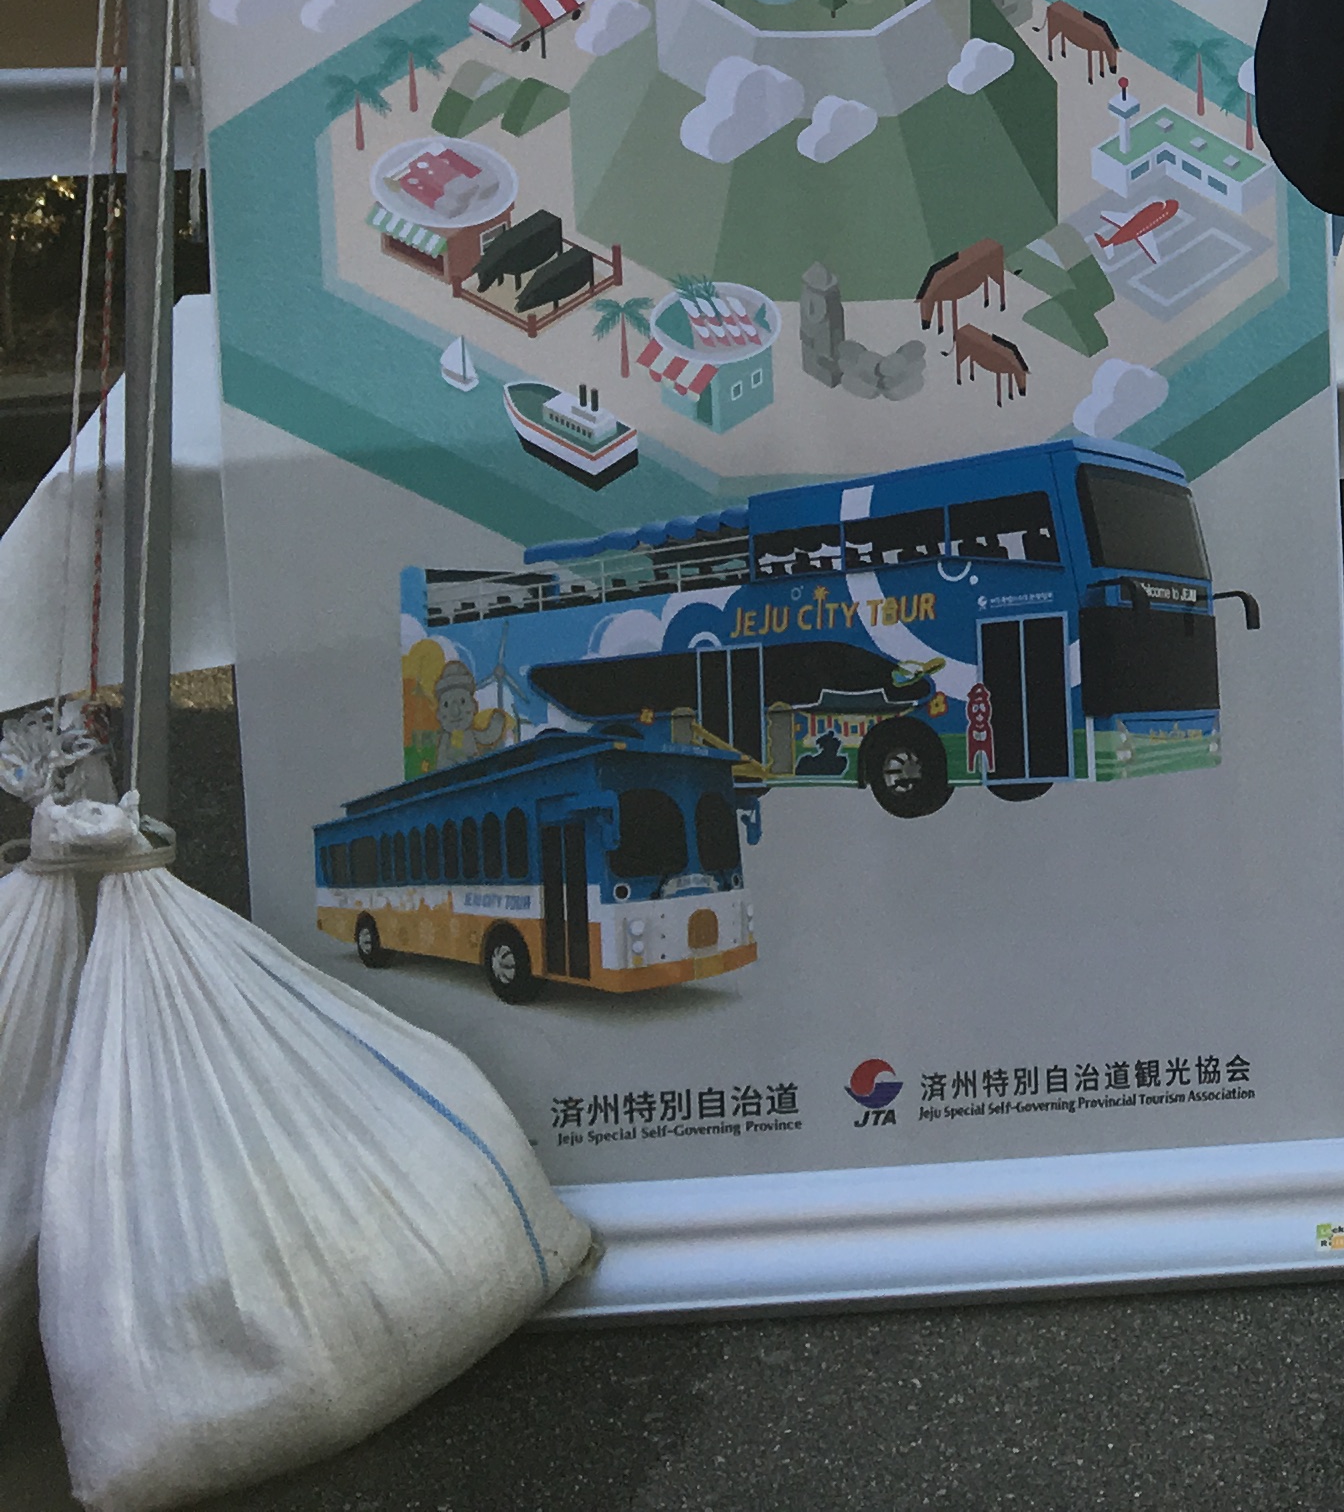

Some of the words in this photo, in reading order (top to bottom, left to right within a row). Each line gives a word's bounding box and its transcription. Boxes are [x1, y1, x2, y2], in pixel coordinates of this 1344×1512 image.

[730, 603, 790, 638] JEJU
[797, 592, 860, 629] CITY
[920, 1053, 1251, 1102] 済州特別自治道観光協会
[550, 1081, 799, 1129] 済州特別自治道
[853, 1109, 897, 1128] JTA
[918, 1106, 941, 1121] Jeju
[944, 1101, 985, 1119] Special
[988, 1095, 1076, 1115] Self-Governing
[1078, 1092, 1136, 1110] Provincial
[1139, 1090, 1186, 1105] Tourism
[1188, 1087, 1256, 1103] Association
[557, 1132, 584, 1147] Jeju
[588, 1126, 637, 1145] Special
[641, 1120, 741, 1140] Self-Governing
[745, 1117, 802, 1132] Province
